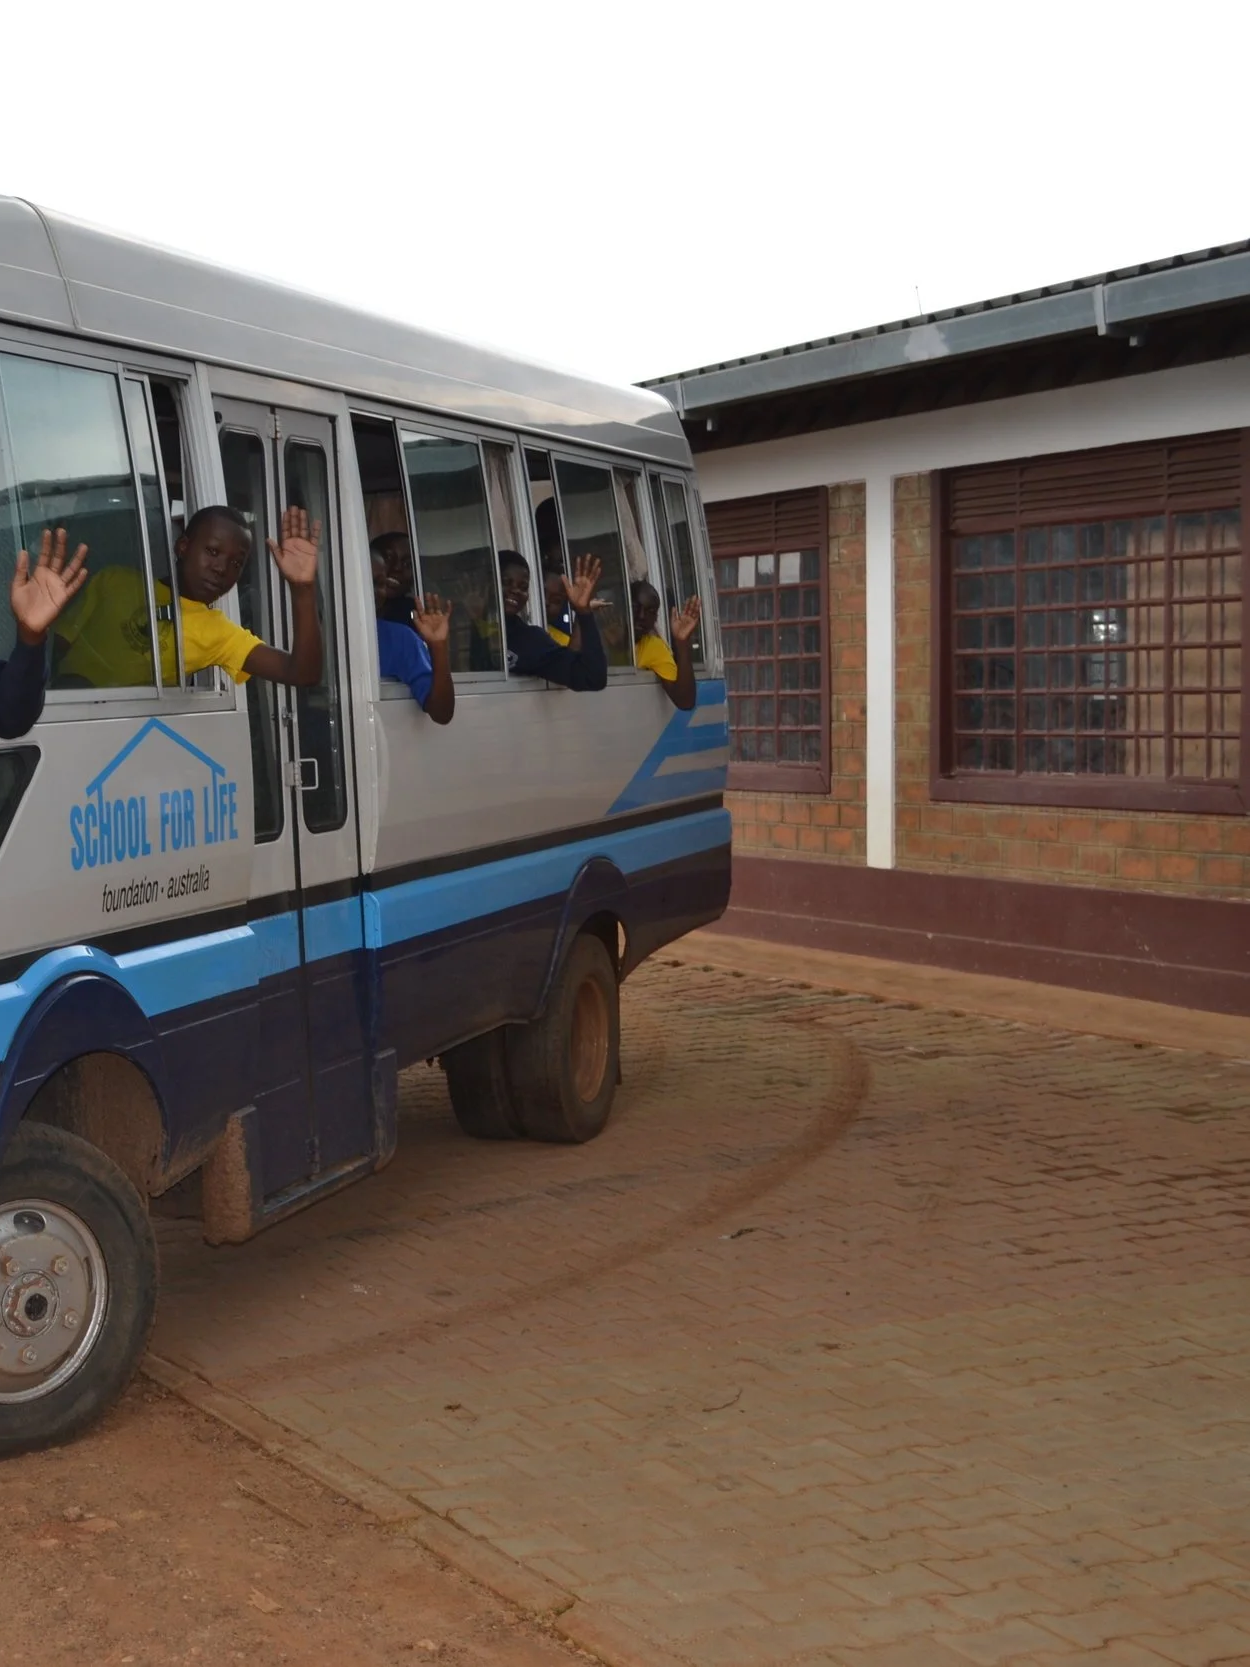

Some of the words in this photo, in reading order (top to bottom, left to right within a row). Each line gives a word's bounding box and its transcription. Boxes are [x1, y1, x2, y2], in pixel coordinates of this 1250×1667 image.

[70, 785, 151, 871] SCHOOL
[159, 789, 196, 853] FOR
[203, 774, 239, 844] LIFE
[101, 879, 159, 914] foundation
[166, 864, 211, 900] australia
